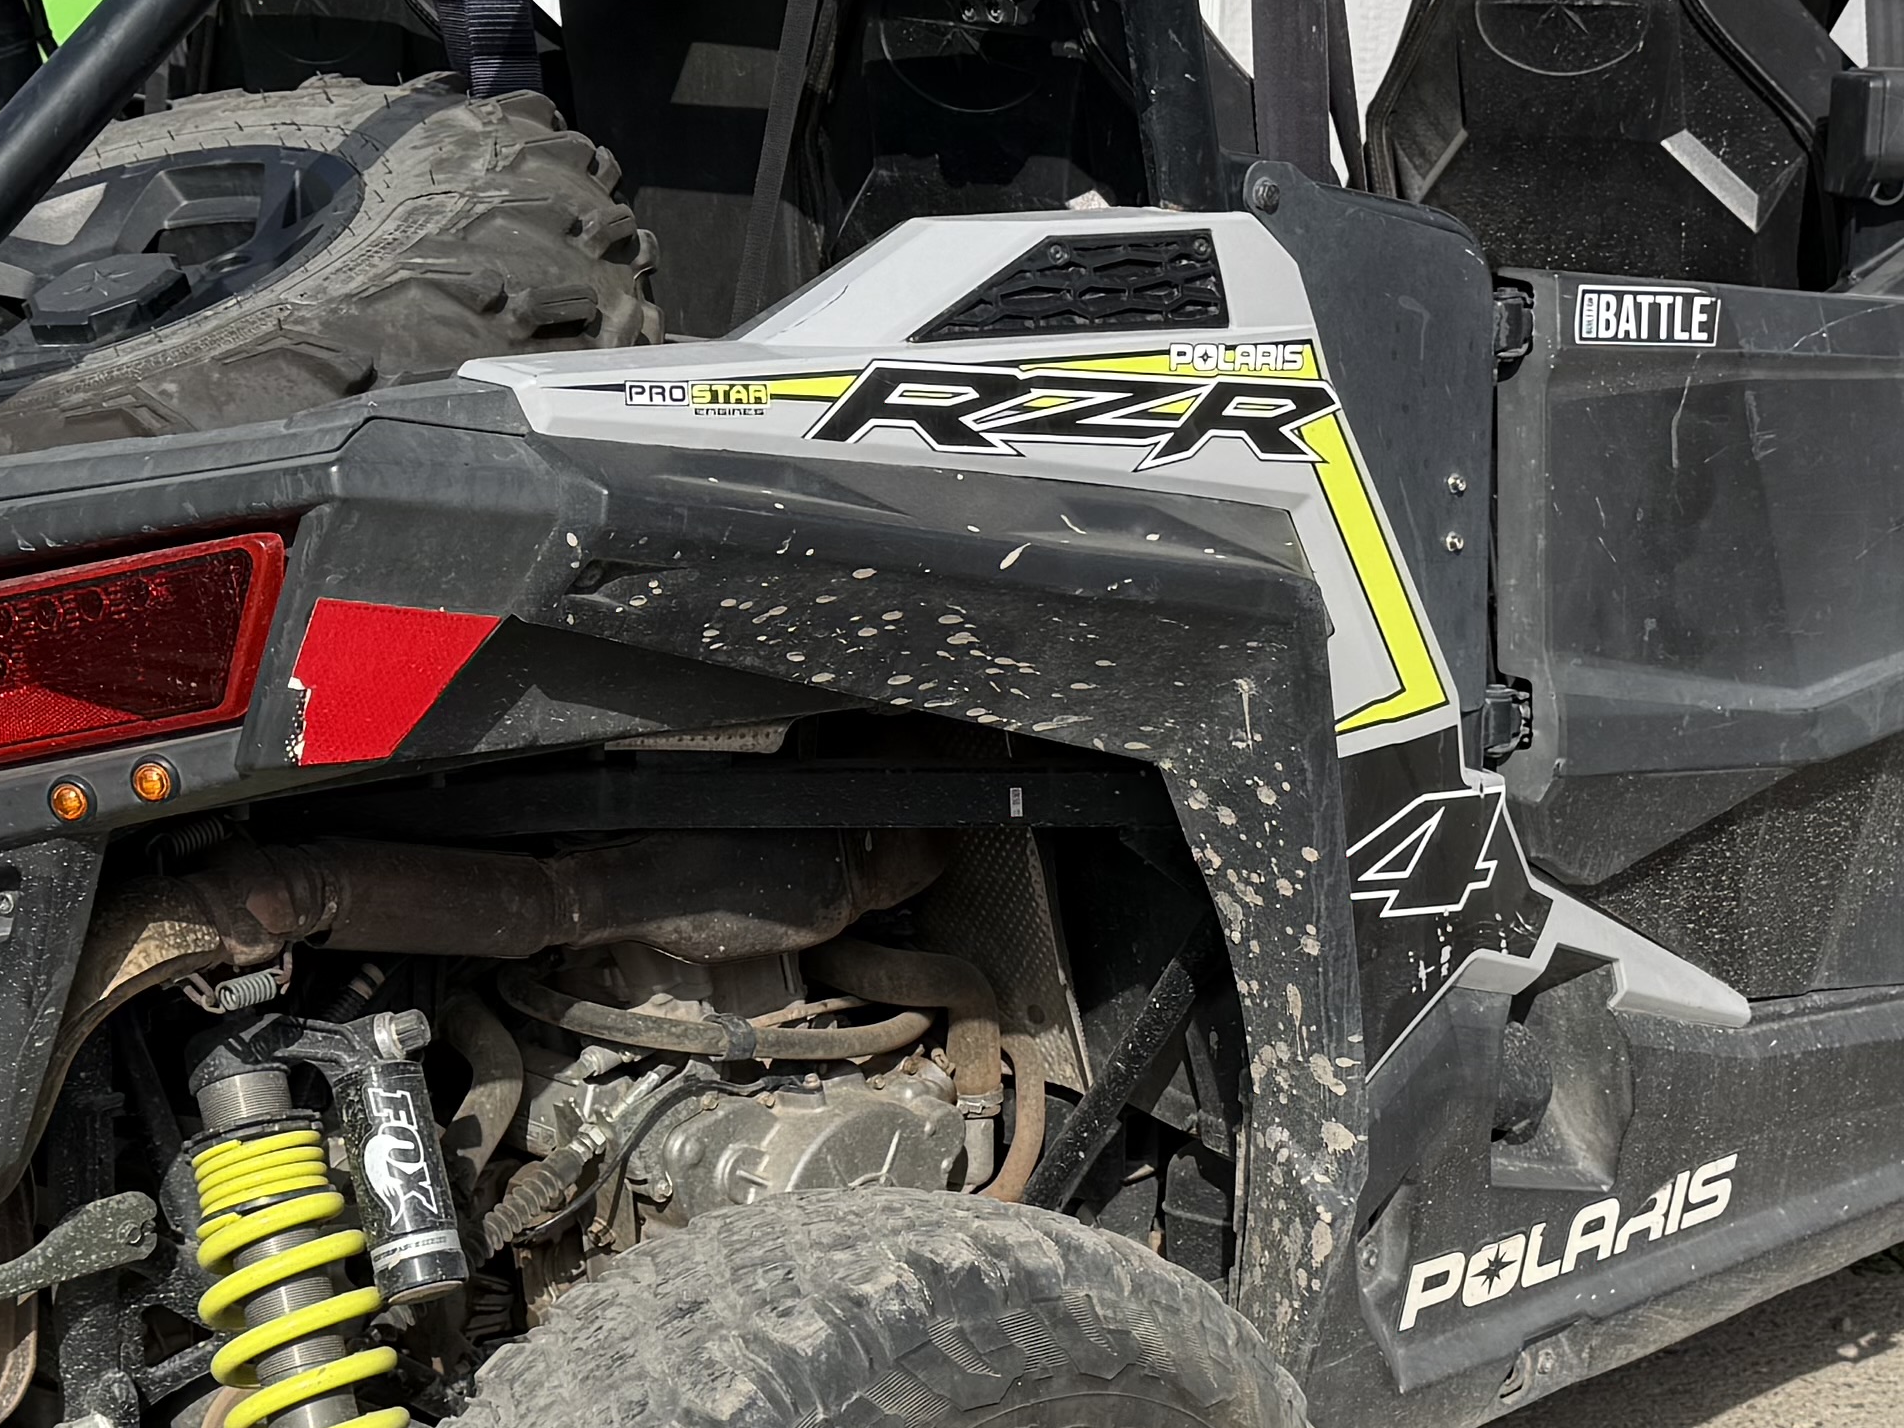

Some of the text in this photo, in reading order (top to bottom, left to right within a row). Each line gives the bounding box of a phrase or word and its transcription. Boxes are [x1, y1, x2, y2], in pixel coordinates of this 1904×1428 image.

[1169, 342, 1305, 372] POLARIS
[1597, 293, 1712, 341] BATTLE
[805, 358, 1342, 470] RZR
[363, 1086, 439, 1226] FOX
[1398, 1153, 1738, 1331] POLARIS
